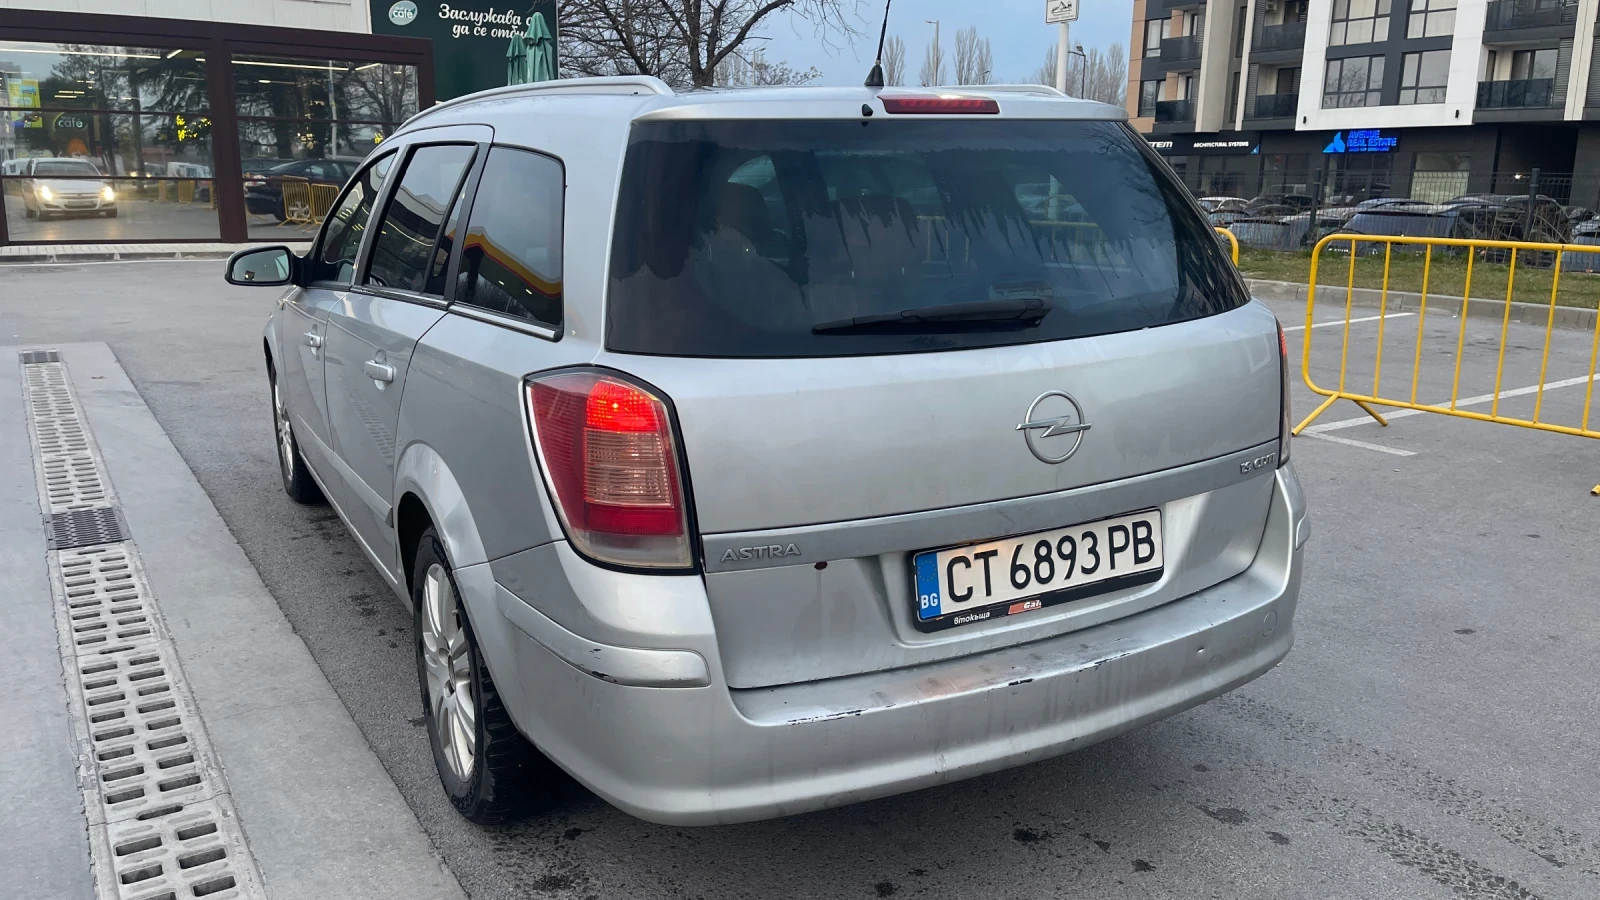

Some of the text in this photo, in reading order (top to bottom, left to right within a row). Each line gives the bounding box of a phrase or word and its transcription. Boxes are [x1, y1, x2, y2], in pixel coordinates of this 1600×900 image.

[392, 8, 413, 19] café
[438, 3, 522, 26] Заслужава
[452, 24, 528, 39] да се отби
[1348, 130, 1380, 138] AVENUE
[1347, 137, 1397, 147] REAL ESTATE
[720, 543, 802, 562] ASTRA
[947, 520, 1156, 603] CT 6893 PB
[920, 593, 938, 609] BG
